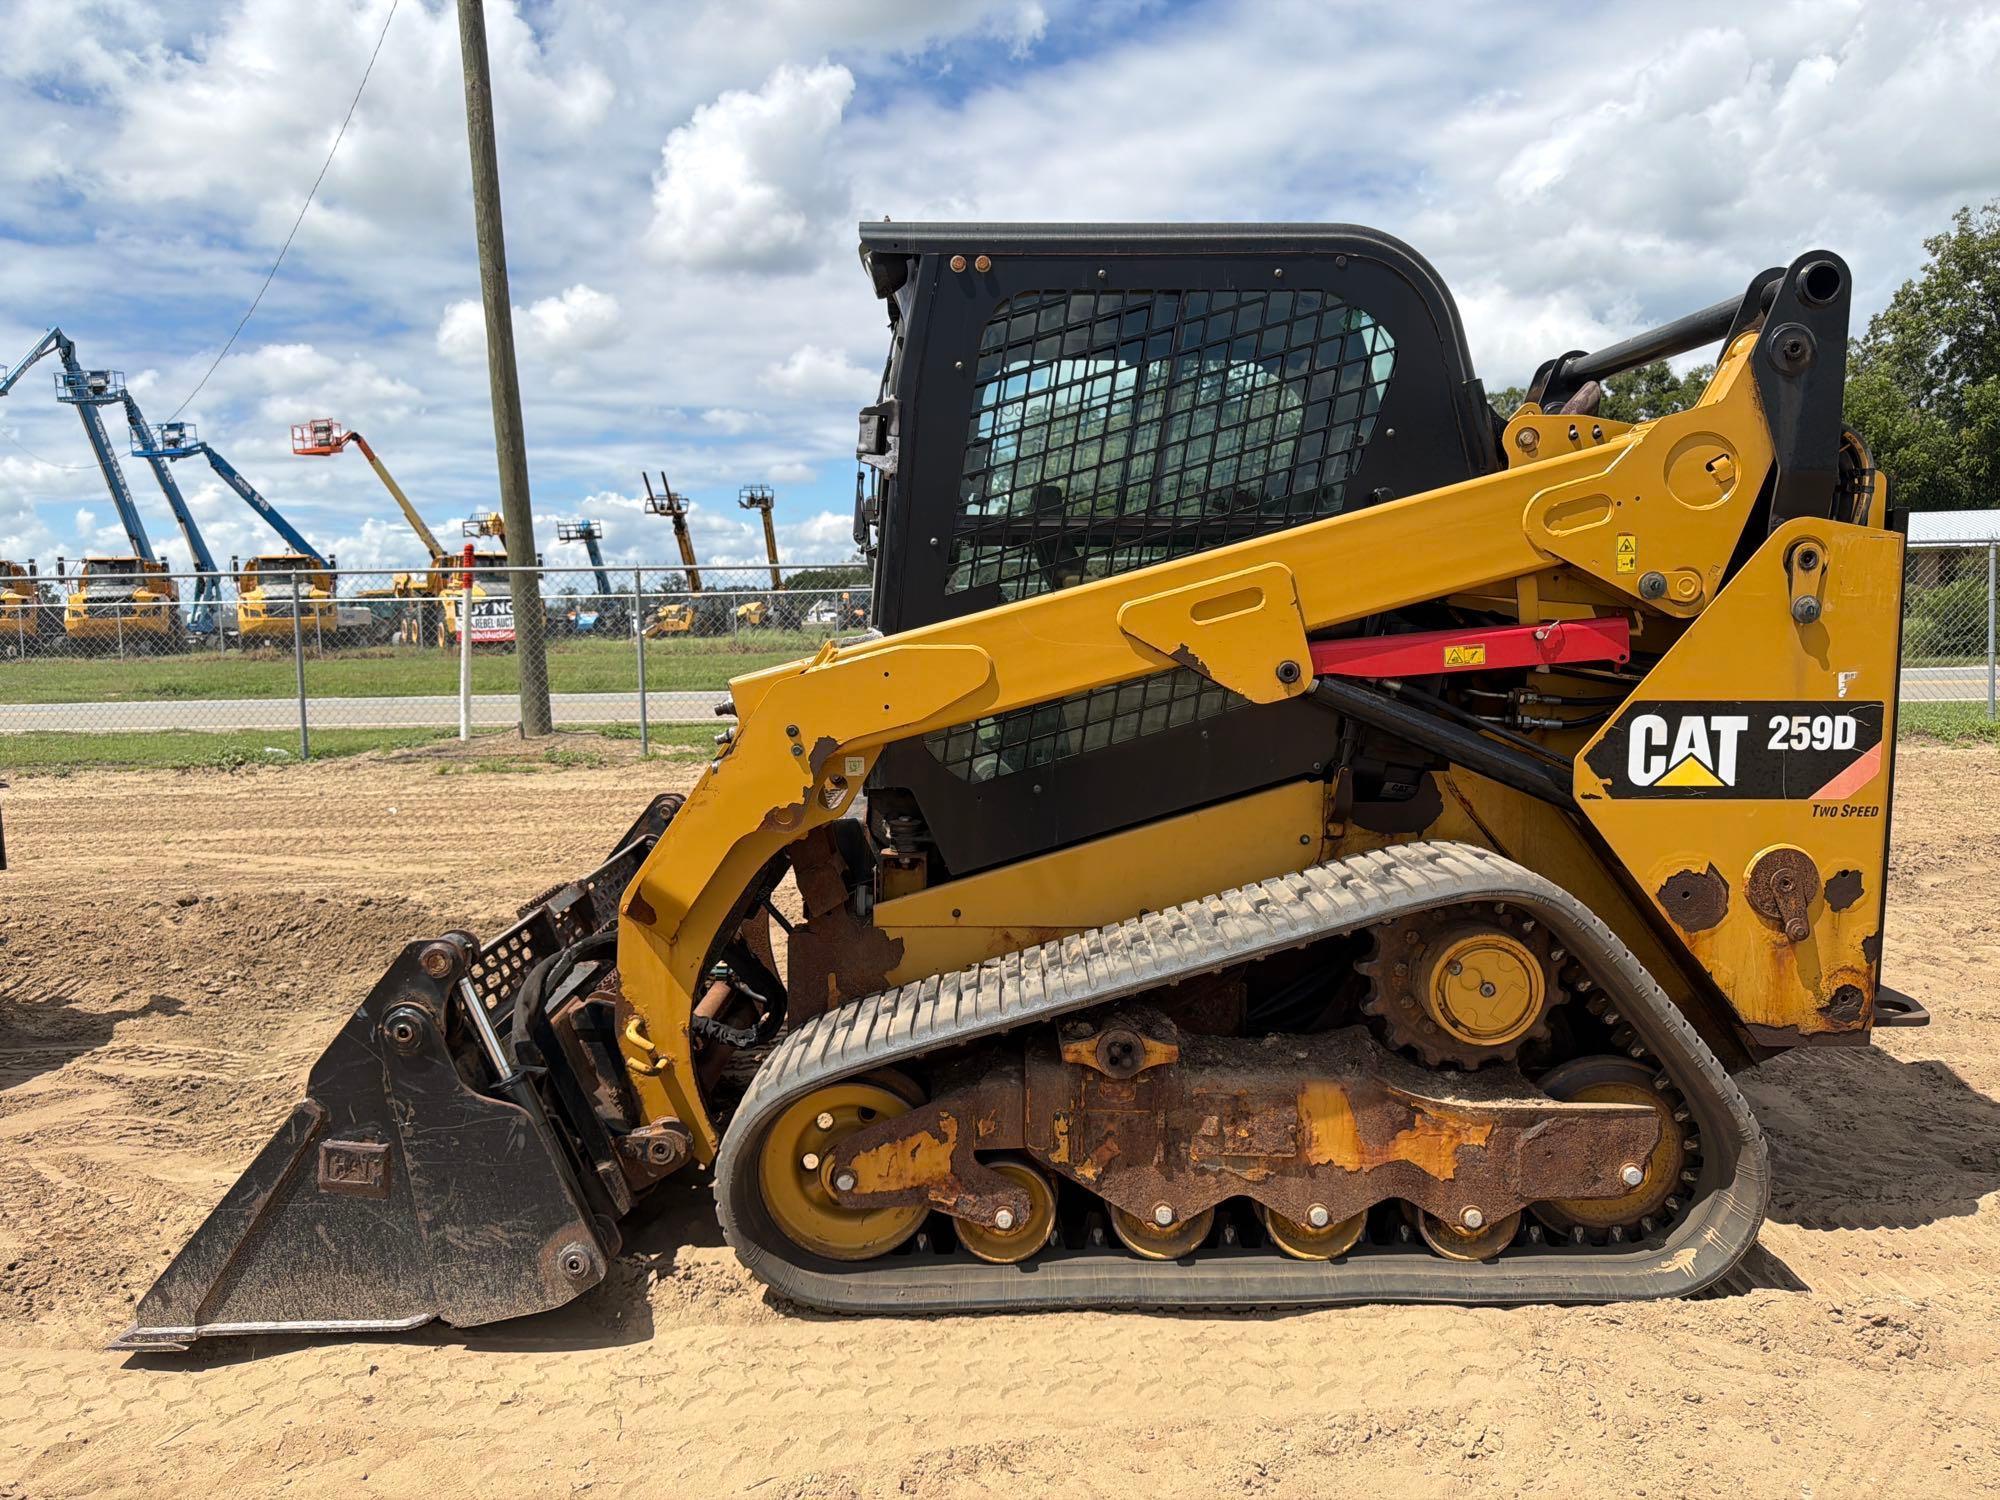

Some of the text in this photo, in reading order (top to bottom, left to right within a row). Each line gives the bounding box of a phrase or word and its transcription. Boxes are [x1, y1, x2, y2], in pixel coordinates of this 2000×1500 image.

[492, 601, 514, 615] NO
[475, 616, 513, 629] REBEL AUCT
[1628, 714, 1857, 786] CAT 259D
